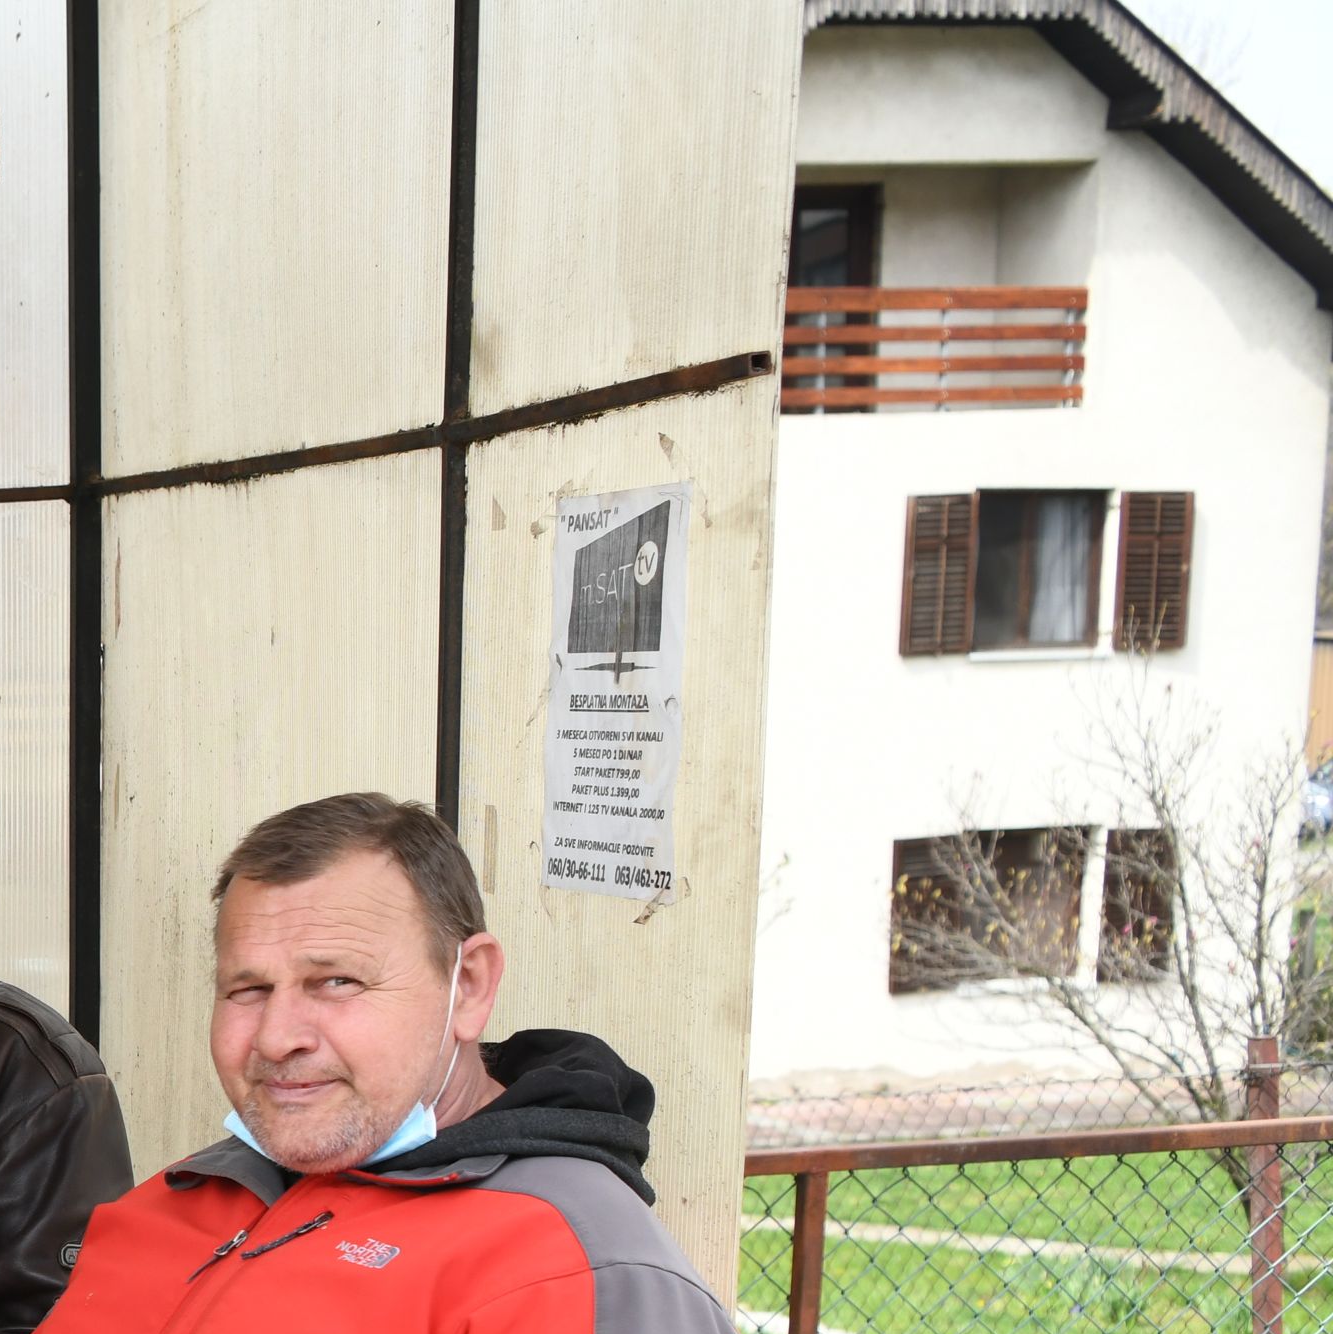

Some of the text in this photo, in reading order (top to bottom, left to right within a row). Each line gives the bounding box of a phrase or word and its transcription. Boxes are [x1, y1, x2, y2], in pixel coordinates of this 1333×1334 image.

[569, 694, 649, 710] BESPLATNA MONTAZA
[556, 729, 664, 743] 3 MESECA OTVORENI SVI KANALI
[573, 748, 578, 759] 5
[579, 748, 601, 759] MESECI
[602, 749, 612, 760] PO
[618, 750, 643, 761] DINAR
[573, 766, 641, 781] START PAKET 799,00
[572, 784, 640, 800] PAKET PLUS 1.399,00
[553, 801, 583, 813] INTERNET
[588, 804, 600, 815] 125
[600, 805, 610, 816] TV
[610, 806, 638, 818] KANALA
[639, 807, 665, 821] 2000,00
[554, 836, 655, 858] ZA SVE INFORMACIJE POZOVITE
[547, 857, 672, 890] 060/30-66-111 063/462-272
[364, 1238, 392, 1254] THE
